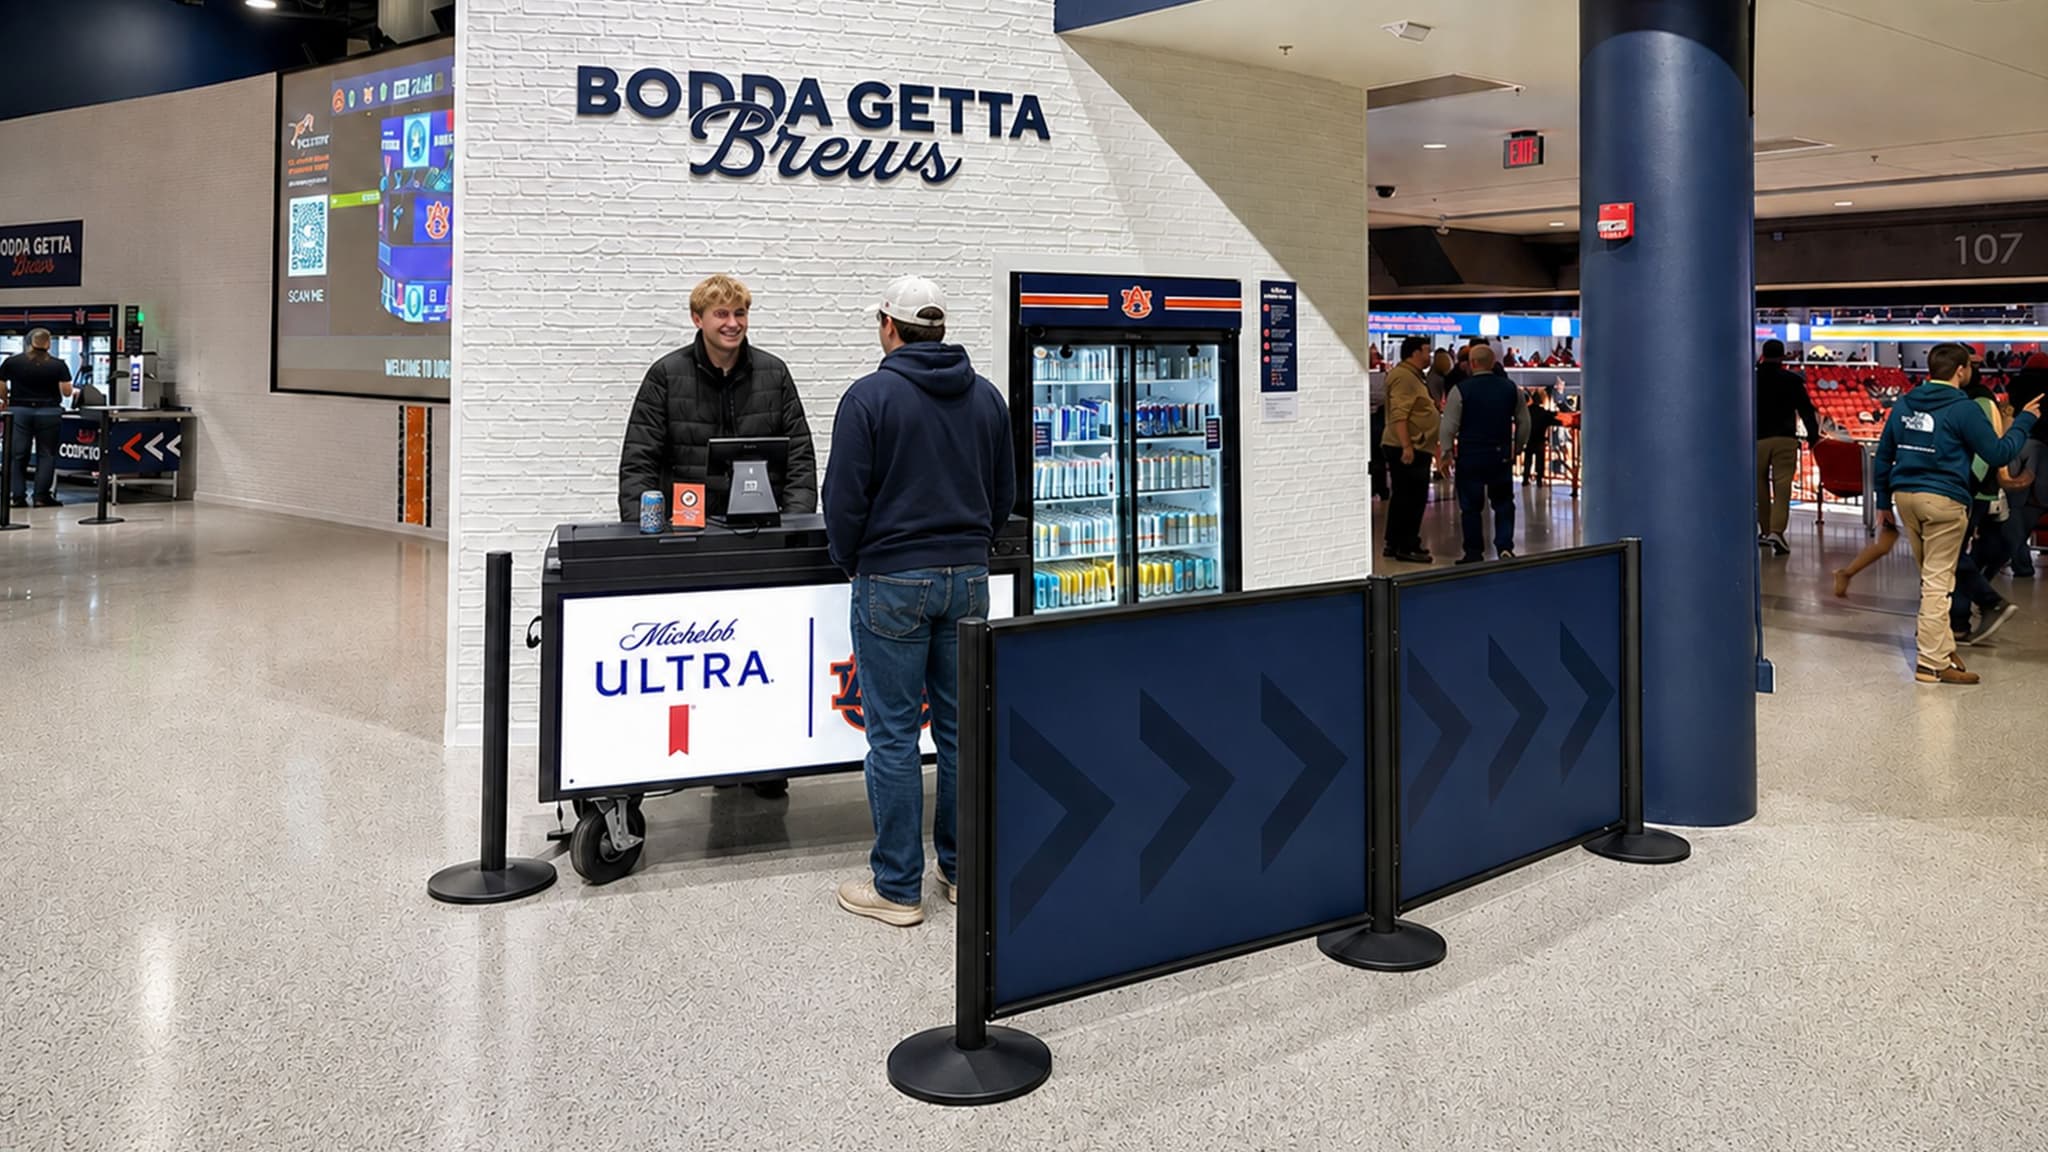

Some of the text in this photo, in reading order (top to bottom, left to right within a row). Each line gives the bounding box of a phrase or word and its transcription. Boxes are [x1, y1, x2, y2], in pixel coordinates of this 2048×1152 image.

[577, 65, 1051, 140] BODDA GETTA
[690, 101, 963, 184] Brews
[1509, 139, 1535, 166] EXIT
[0, 235, 73, 257] ODDA GETTA
[1954, 232, 2023, 265] 107
[287, 288, 325, 304] SCAN ME
[385, 358, 421, 377] WELCOME
[422, 359, 432, 378] TO
